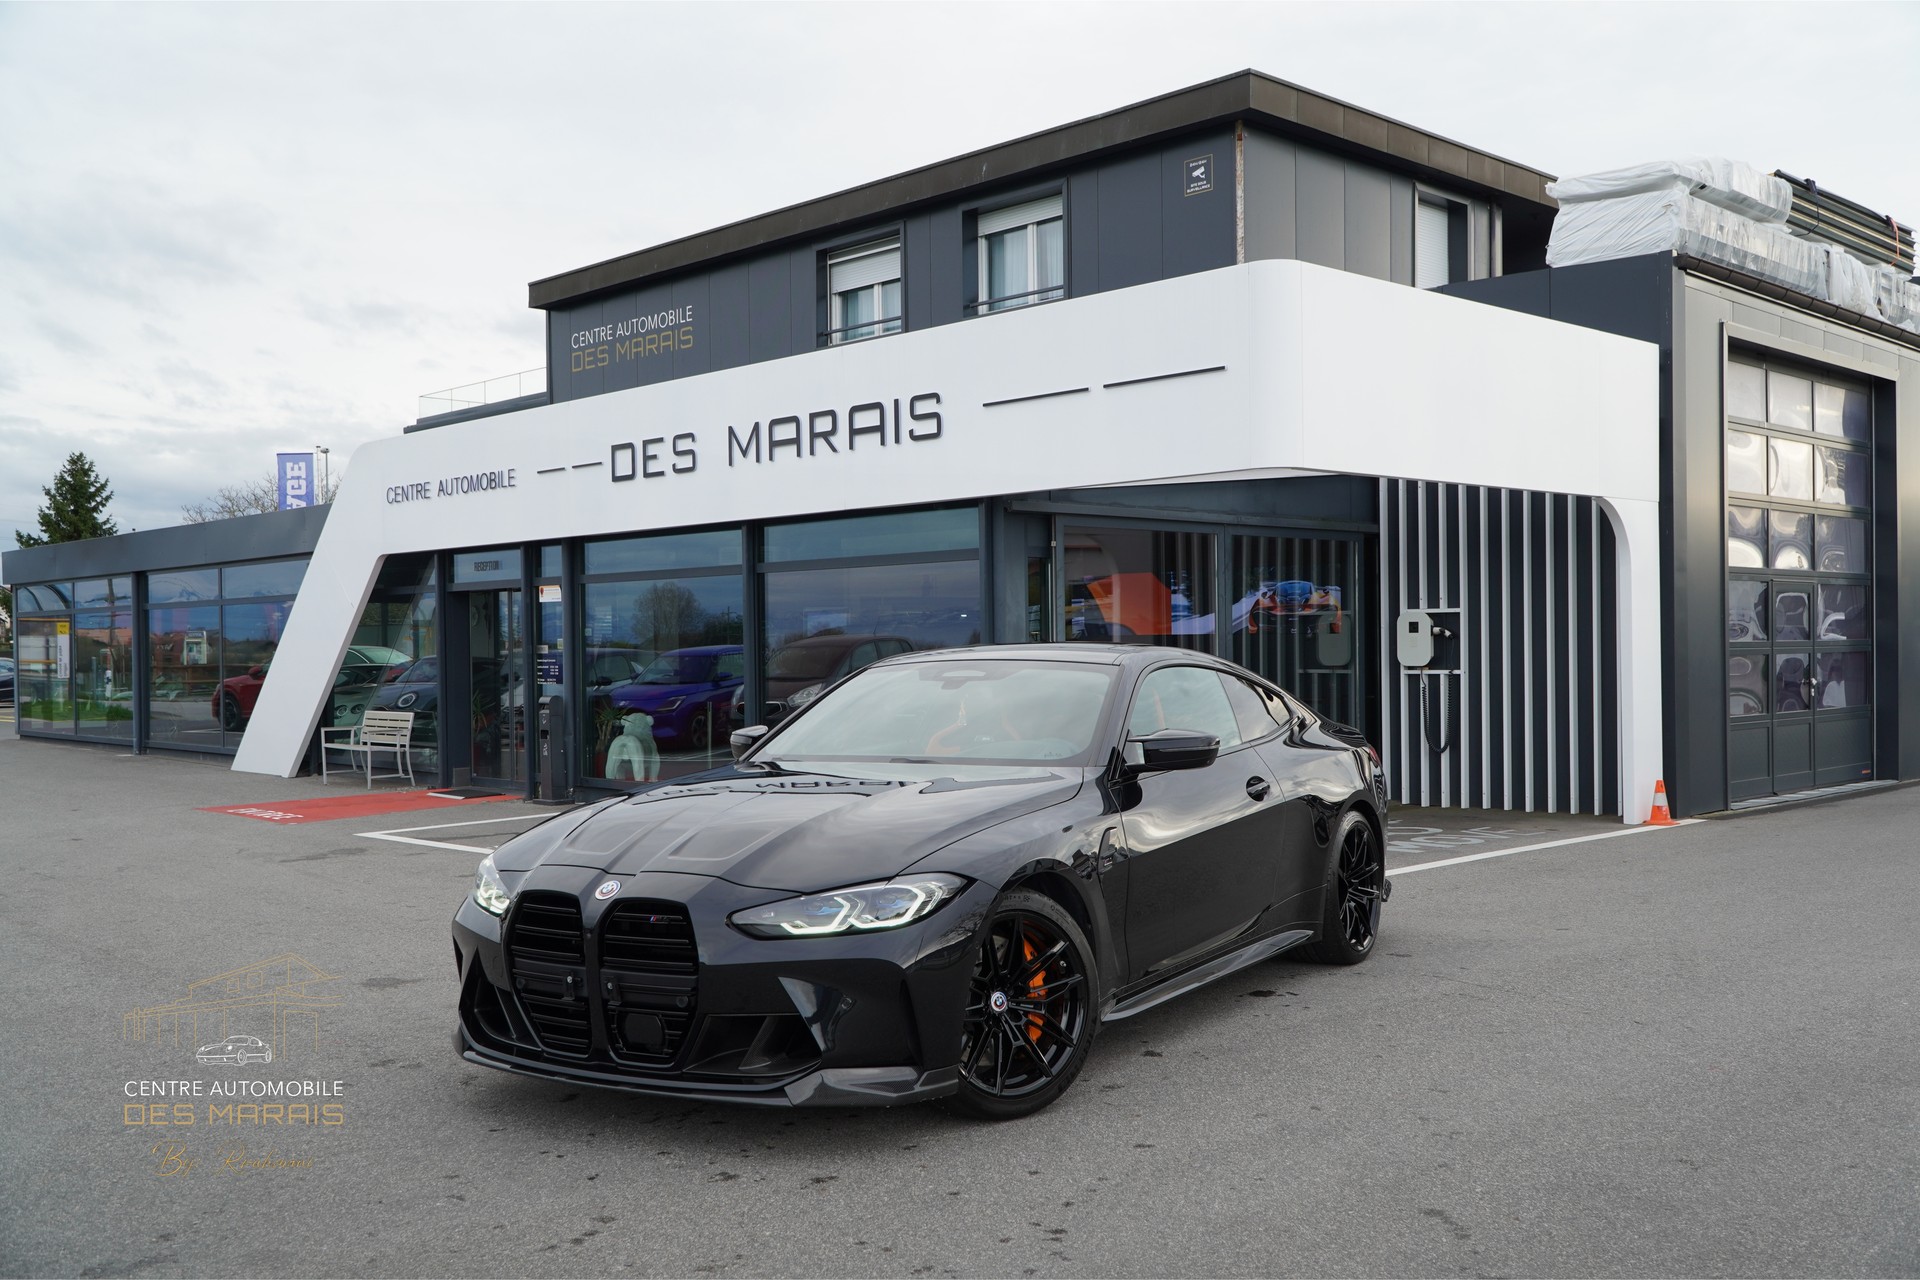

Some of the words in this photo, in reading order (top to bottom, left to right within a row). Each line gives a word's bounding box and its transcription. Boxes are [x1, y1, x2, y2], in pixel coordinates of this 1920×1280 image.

[571, 325, 613, 349] CENTRE
[616, 306, 693, 338] AUTOMOBILE
[571, 345, 609, 373] DES
[615, 326, 693, 363] MARAIS
[386, 481, 431, 504] CENTRE
[437, 468, 516, 497] AUTOMOBILE
[611, 432, 697, 482] DES
[728, 392, 943, 467] MARAIS
